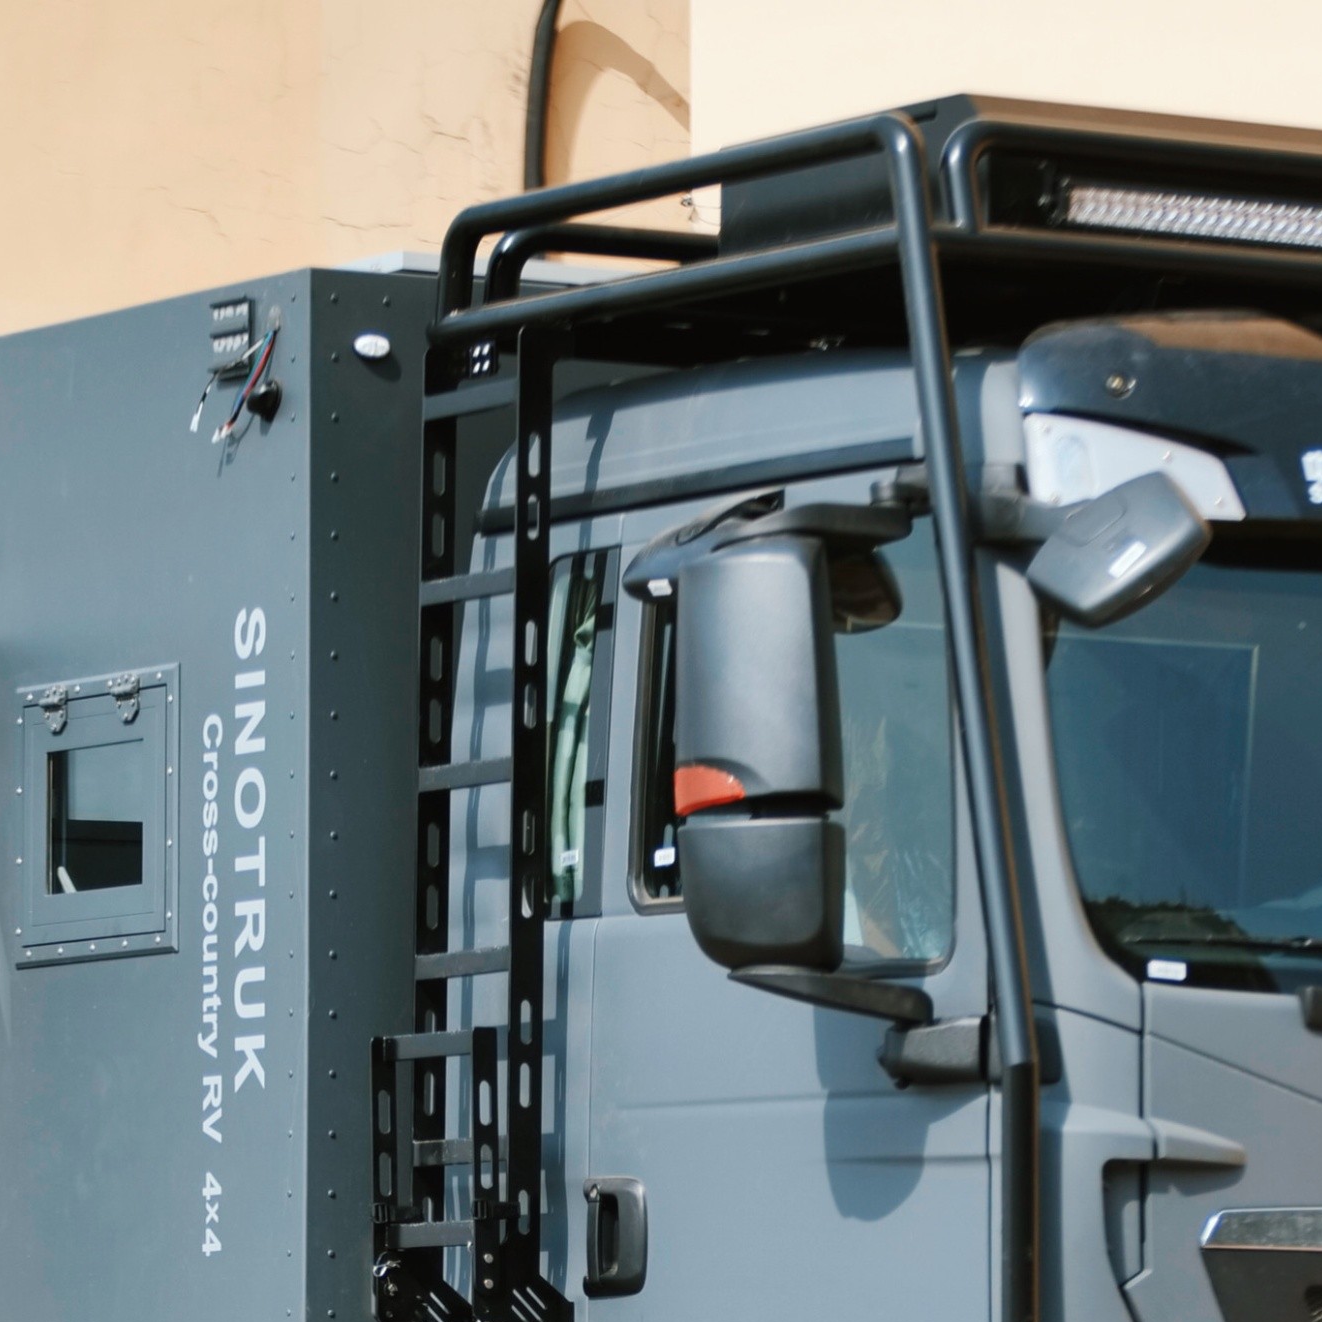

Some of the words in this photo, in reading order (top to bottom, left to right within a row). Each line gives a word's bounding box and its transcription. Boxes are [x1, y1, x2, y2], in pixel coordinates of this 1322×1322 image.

[197, 712, 224, 1059] Cross-country
[233, 605, 268, 1093] SINOTRUK
[200, 1074, 224, 1145] RV
